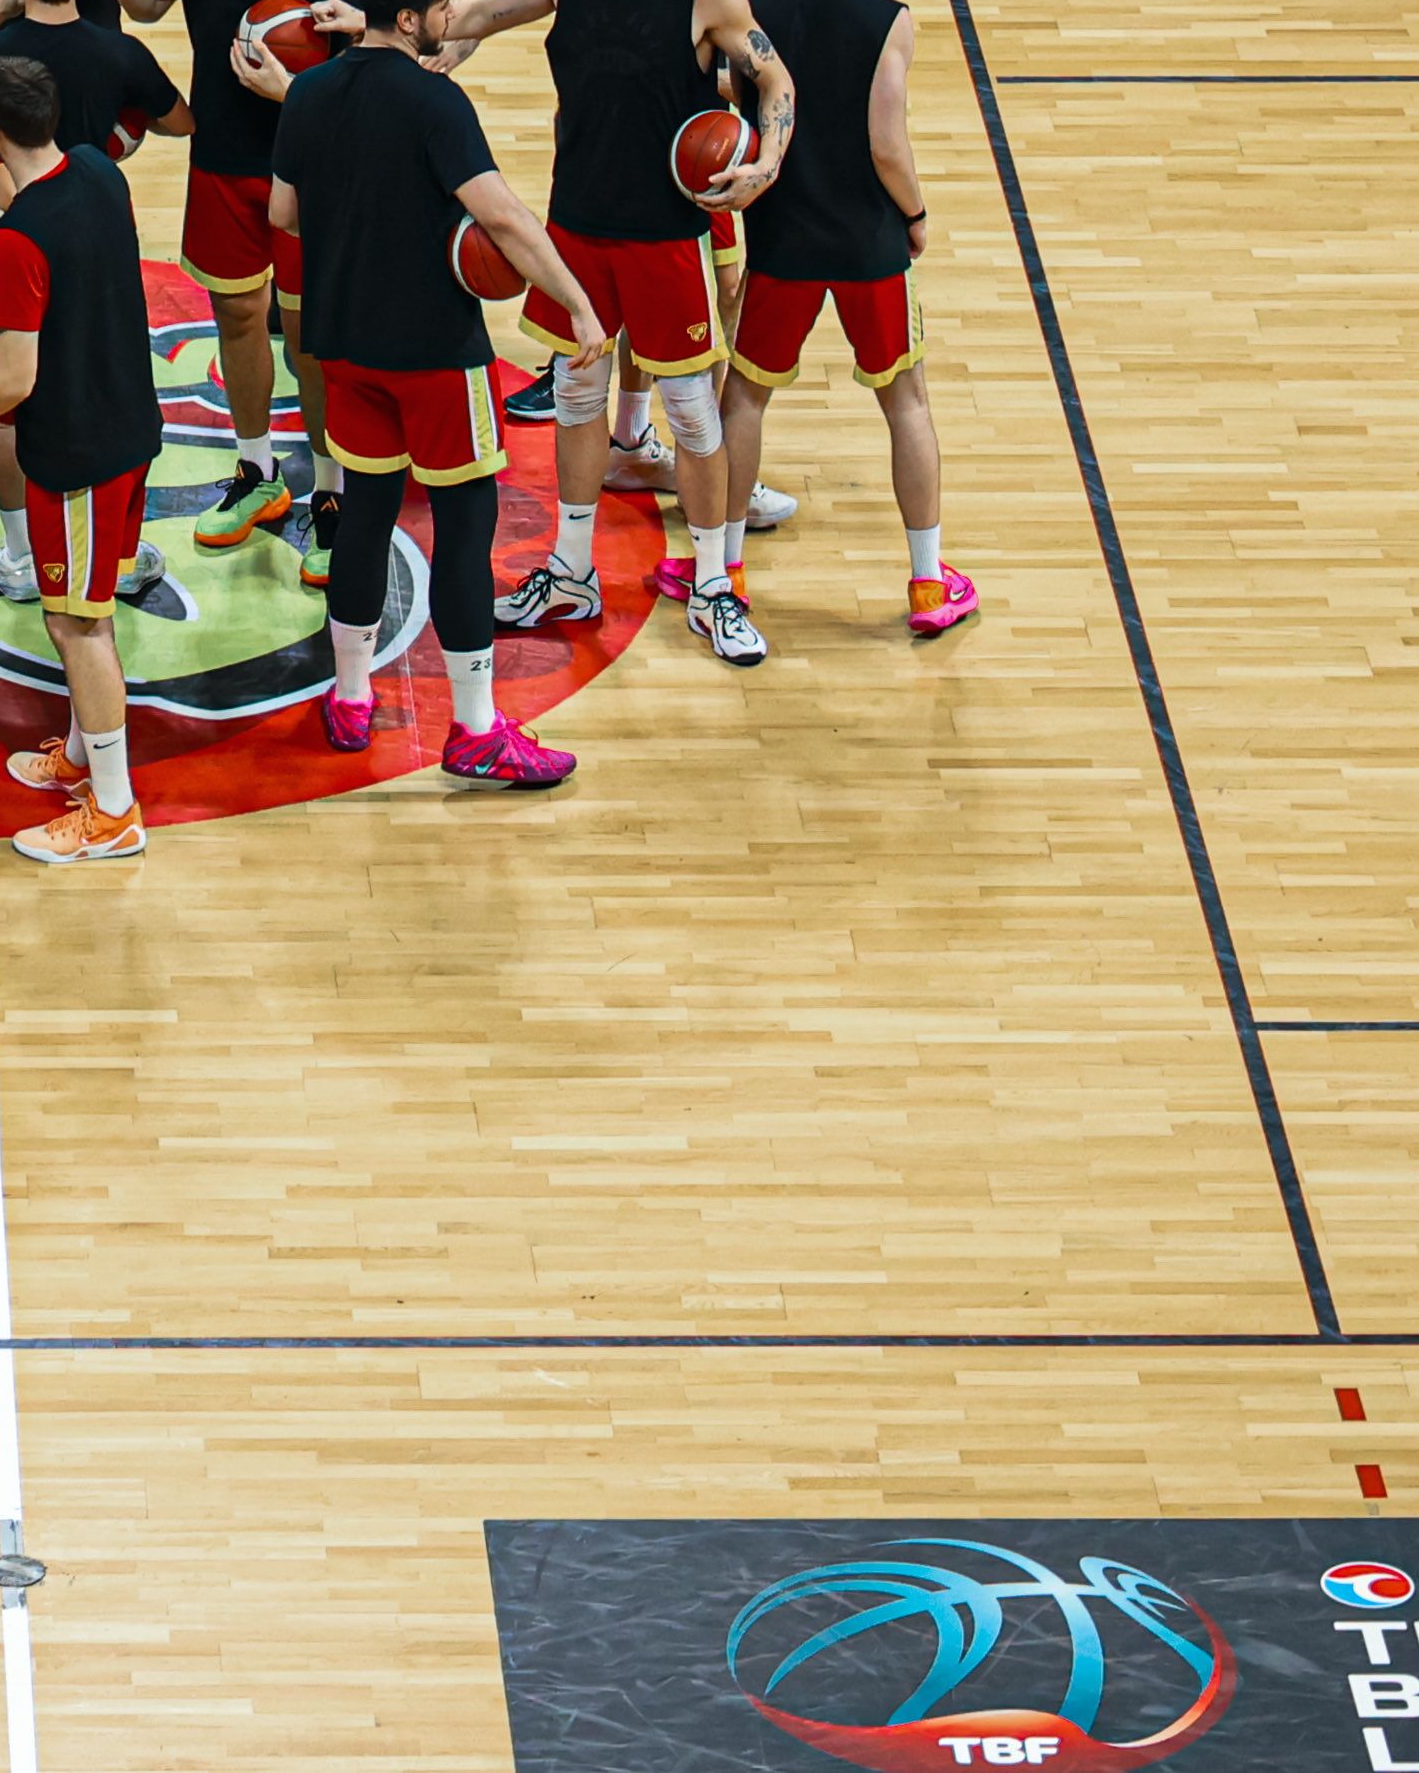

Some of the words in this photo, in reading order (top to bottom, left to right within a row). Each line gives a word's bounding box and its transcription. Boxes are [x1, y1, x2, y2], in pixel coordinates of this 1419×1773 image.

[470, 658, 491, 672] 23
[1333, 1621, 1419, 1665] T
[938, 1736, 1060, 1765] TBF
